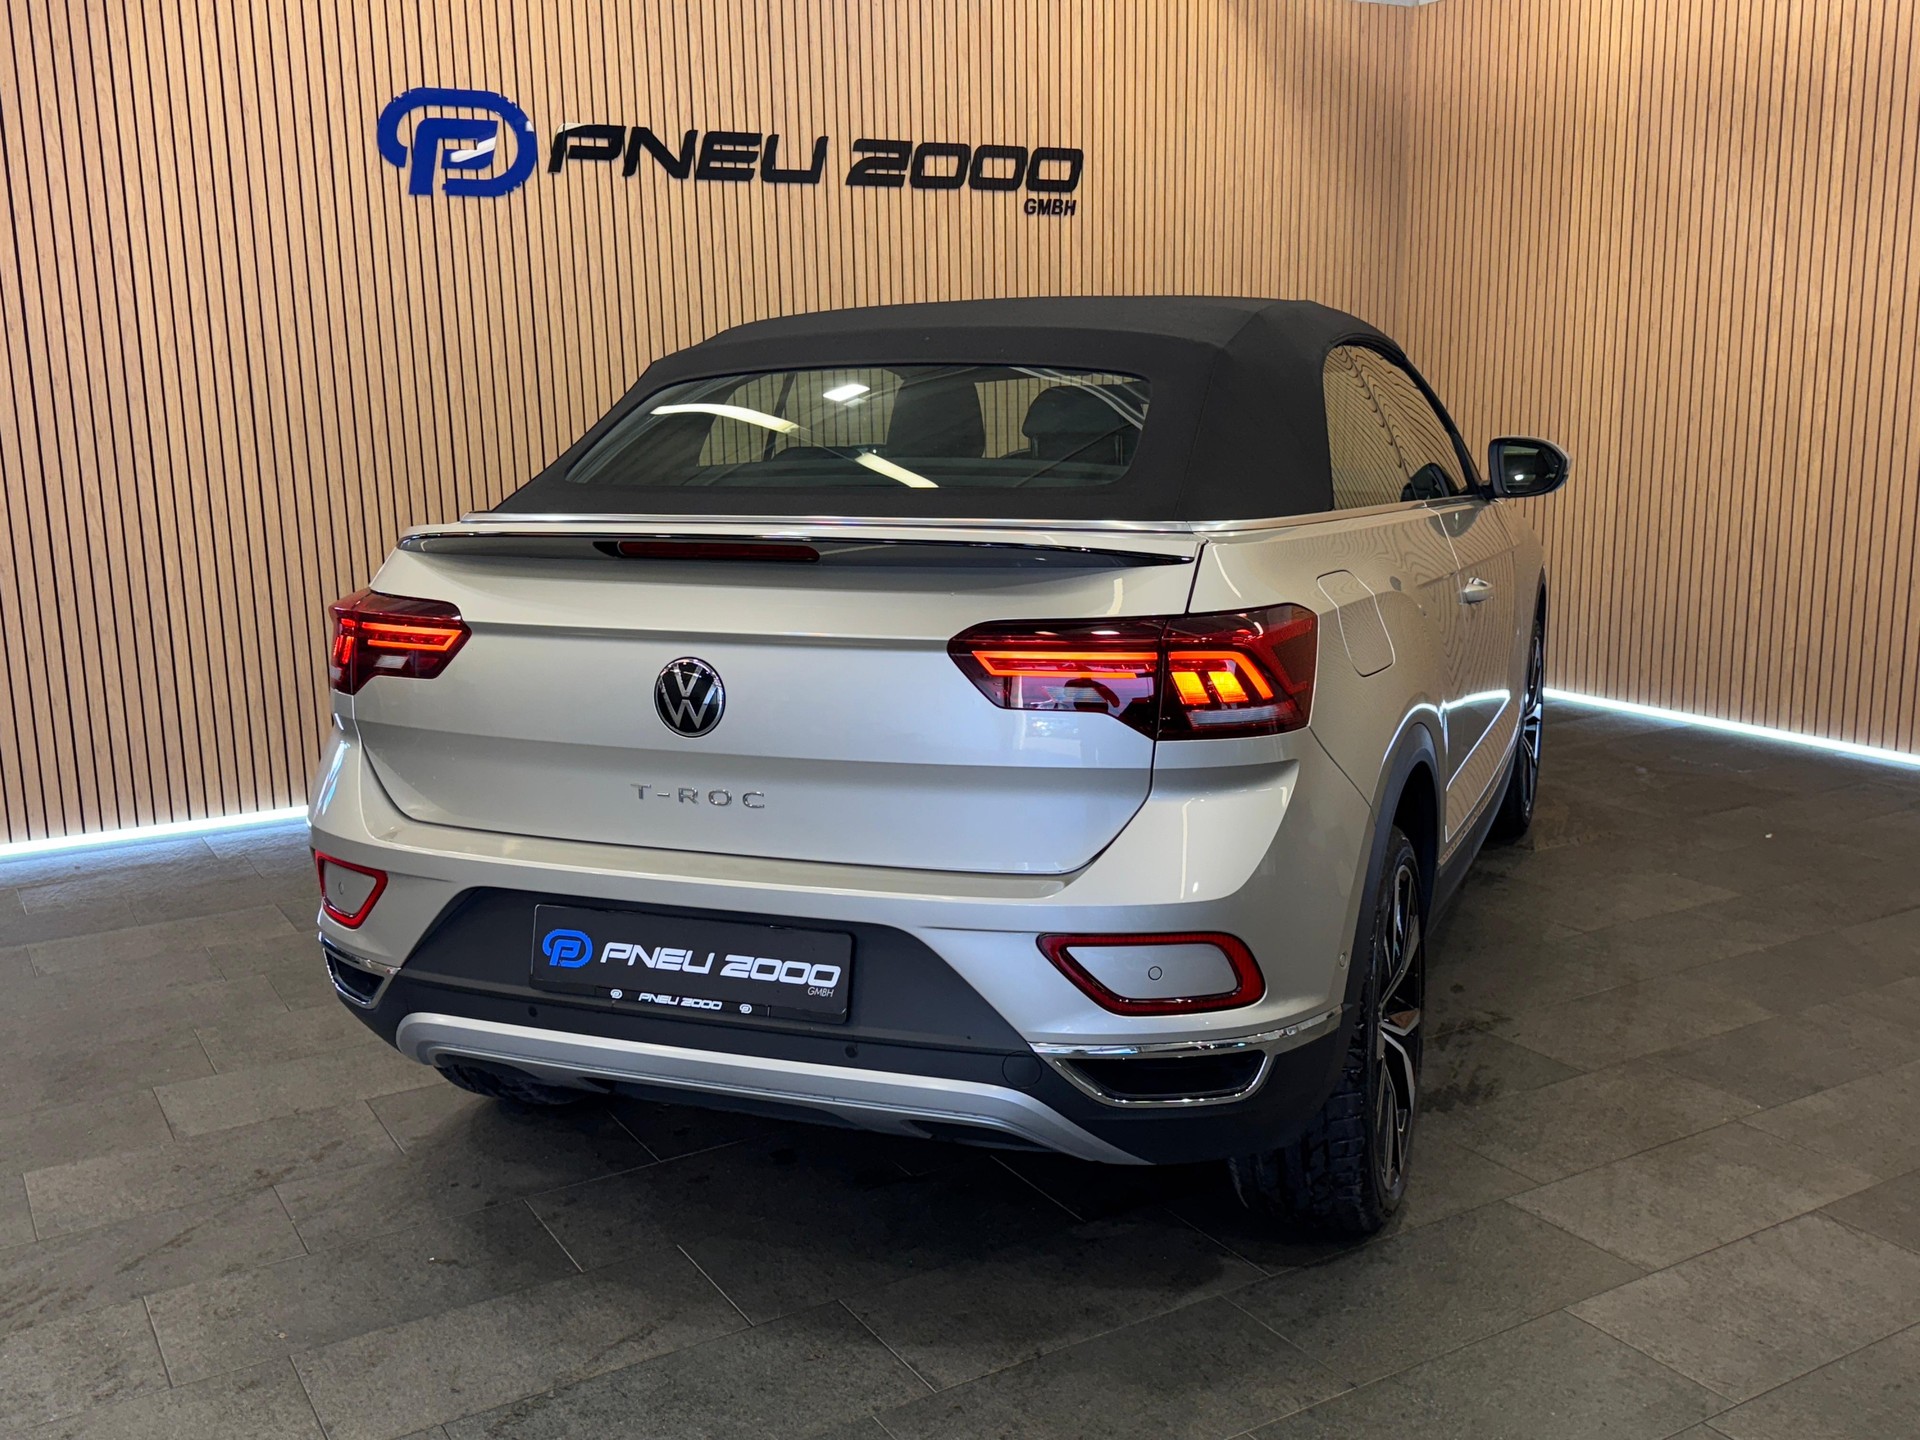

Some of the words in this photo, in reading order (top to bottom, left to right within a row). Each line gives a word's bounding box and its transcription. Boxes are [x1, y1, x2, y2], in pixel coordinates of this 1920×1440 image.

[548, 123, 829, 184] PNEU
[845, 138, 1084, 193] 2000
[1023, 198, 1078, 217] GMBH
[630, 783, 765, 809] T-ROC
[600, 941, 715, 975] PNEU
[719, 954, 841, 988] 2000
[638, 992, 679, 1006] PNEU
[680, 997, 722, 1011] 2000
[807, 986, 834, 998] GMBH
